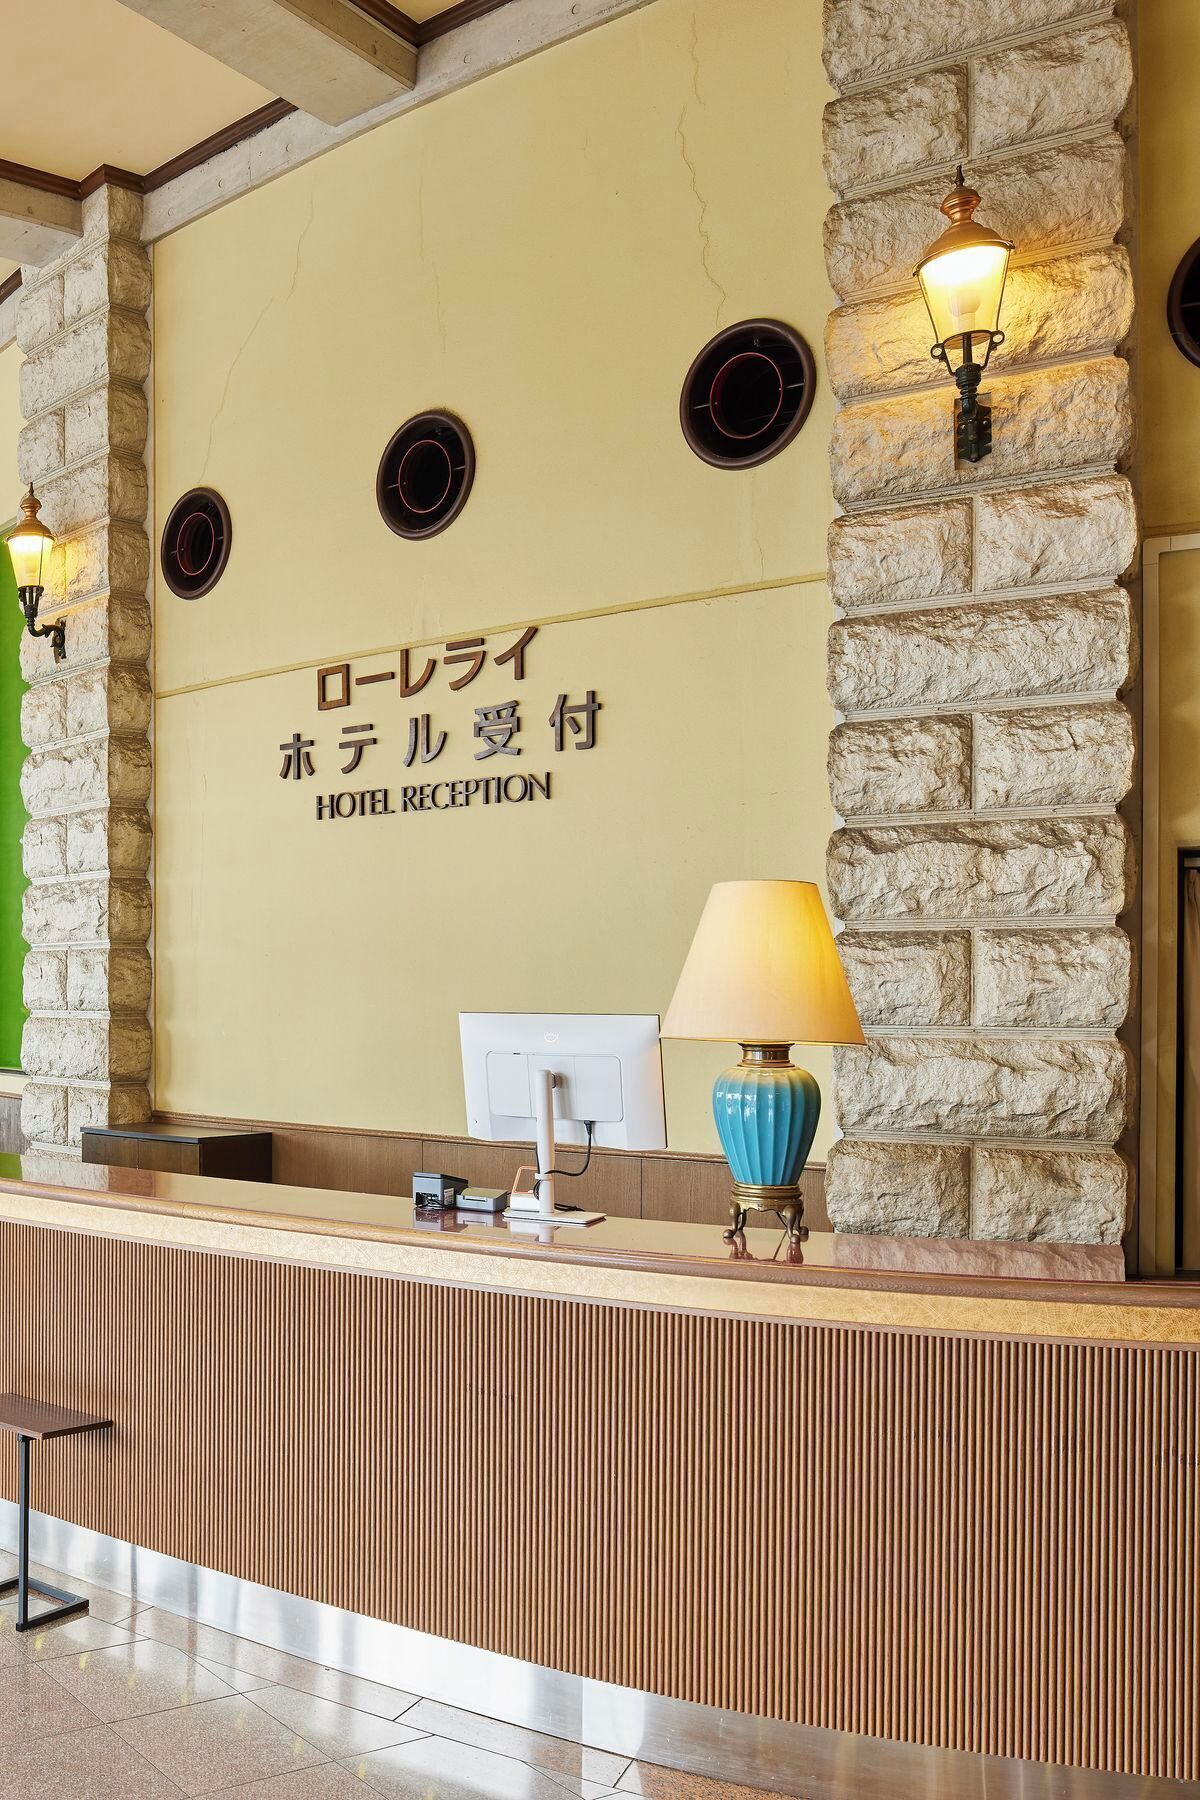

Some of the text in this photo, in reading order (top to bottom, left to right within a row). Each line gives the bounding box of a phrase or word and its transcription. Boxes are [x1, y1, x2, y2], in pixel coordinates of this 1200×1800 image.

[317, 626, 538, 711] ローレライ
[279, 690, 602, 780] ホテル受付
[316, 771, 551, 820] HOTEL RECEPTION
